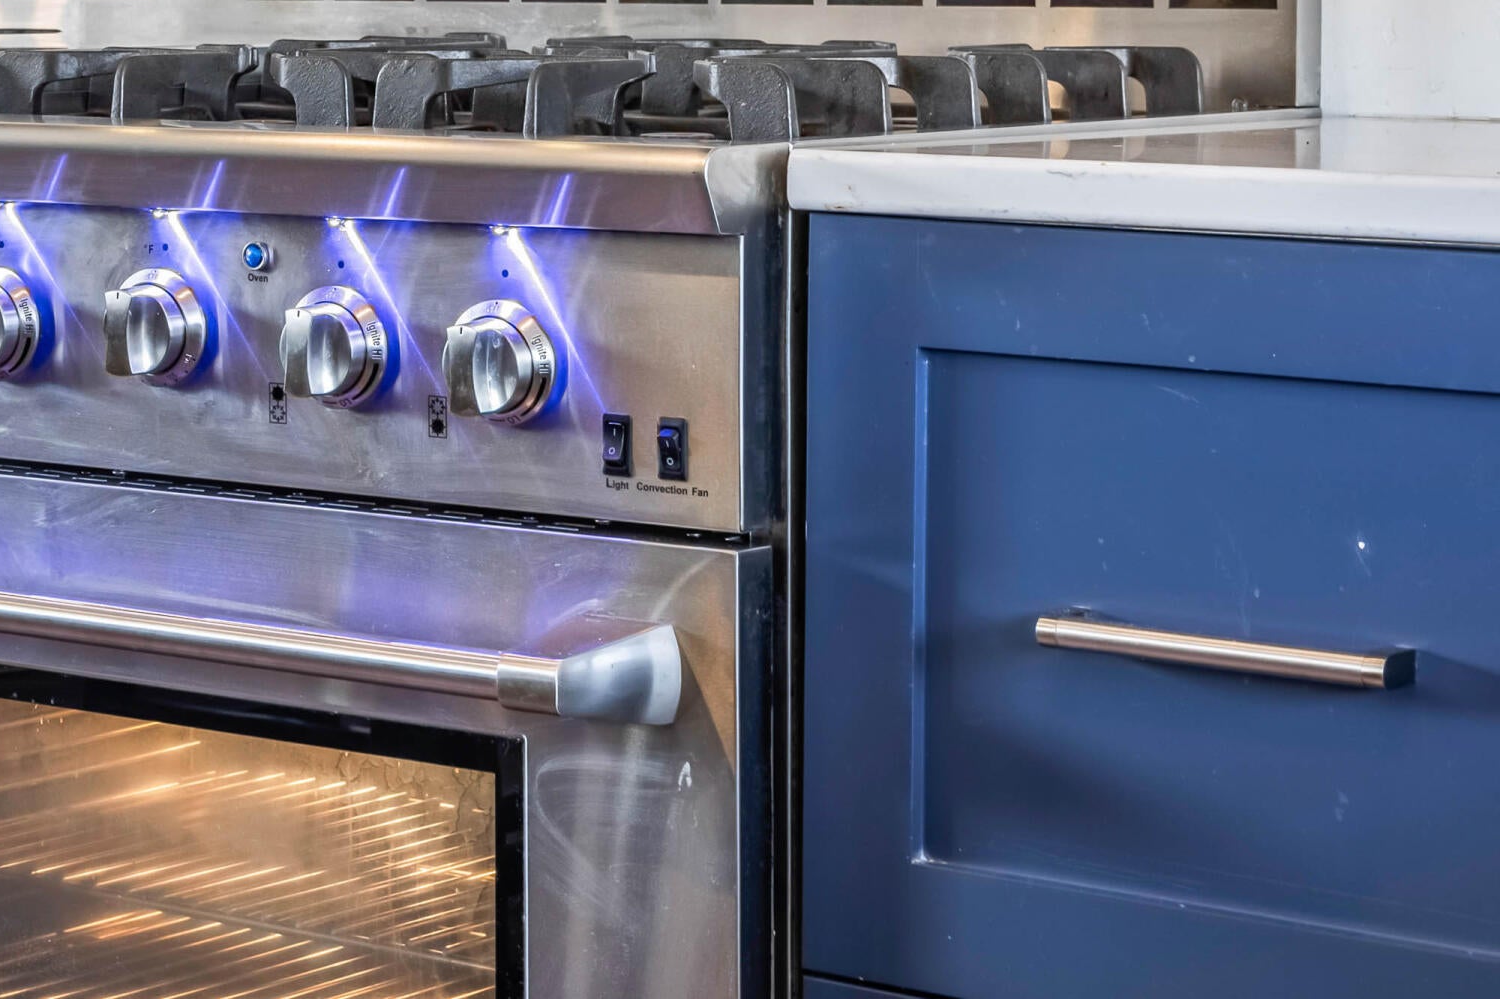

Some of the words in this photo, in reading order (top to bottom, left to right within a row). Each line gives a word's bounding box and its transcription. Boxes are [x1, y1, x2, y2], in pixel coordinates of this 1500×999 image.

[246, 272, 269, 283] Oven
[18, 298, 34, 323] Ignite
[365, 321, 382, 347] Ignite
[371, 348, 383, 361] HI
[531, 335, 548, 361] Ignite
[539, 363, 551, 375] HI
[605, 477, 630, 492] Light
[636, 481, 688, 497] Convection
[691, 487, 709, 498] Fan
